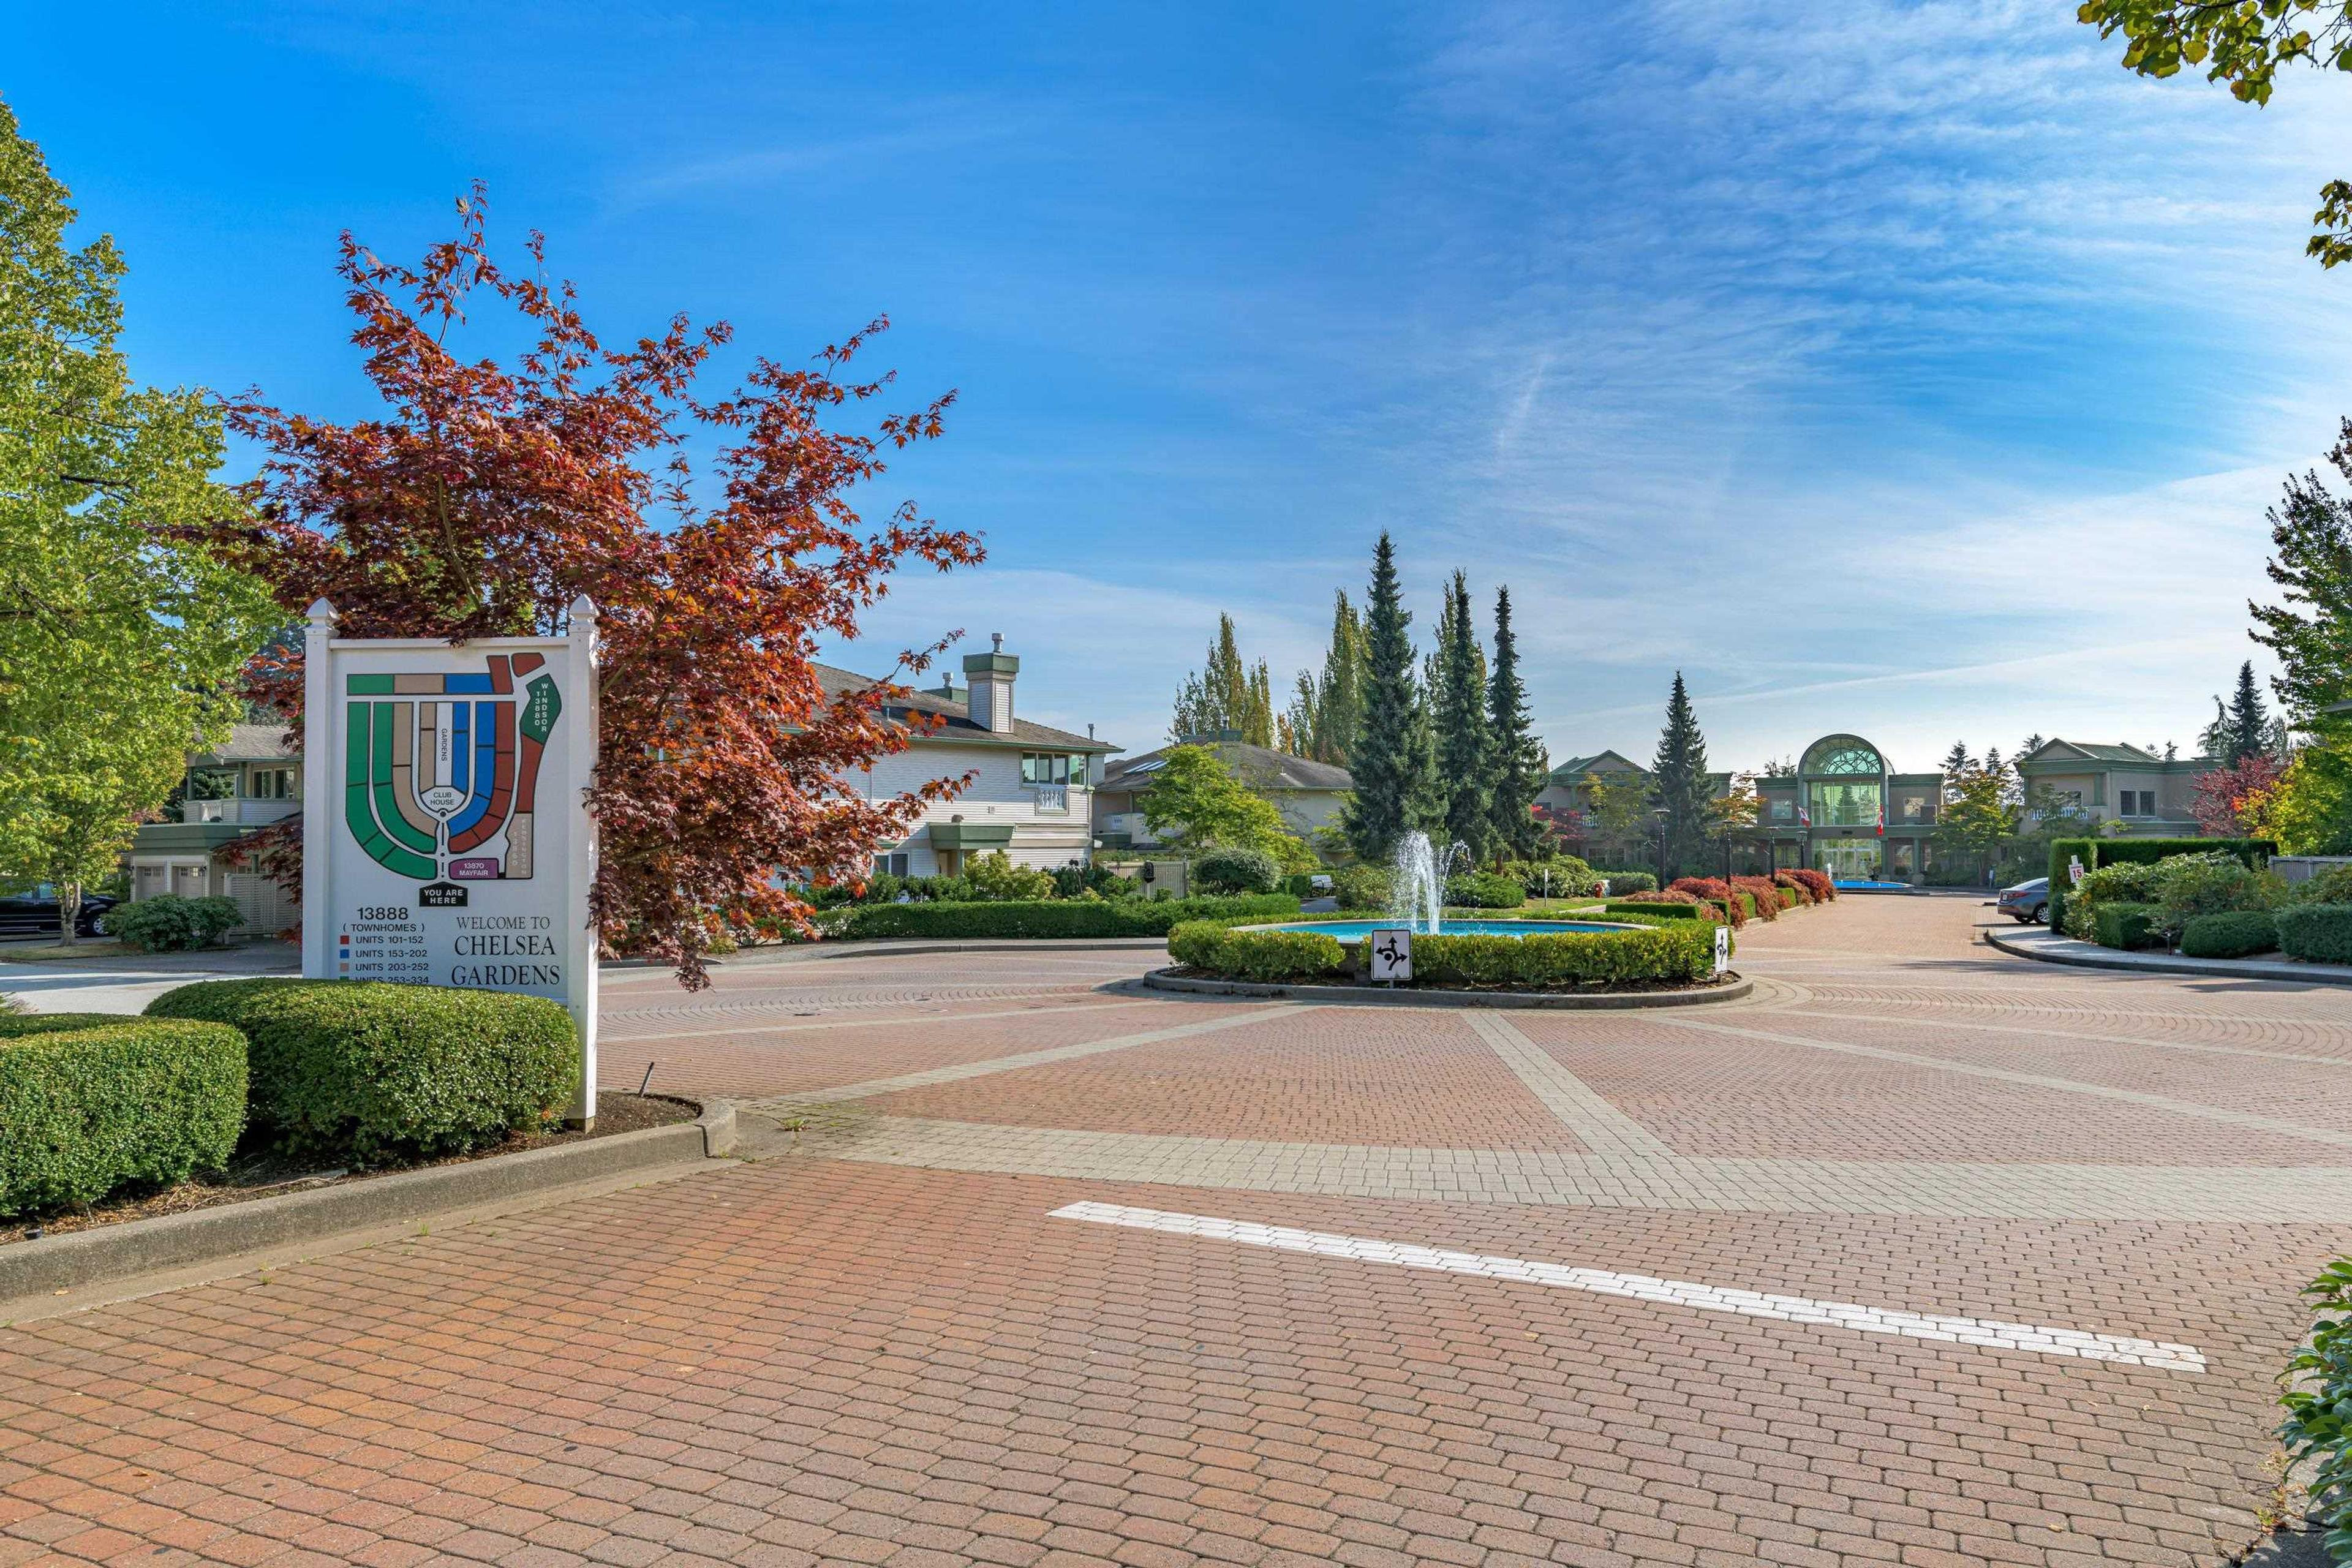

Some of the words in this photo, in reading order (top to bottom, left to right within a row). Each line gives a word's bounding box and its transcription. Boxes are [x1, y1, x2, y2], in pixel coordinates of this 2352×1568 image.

[2073, 869, 2082, 878] 15
[357, 907, 409, 920] 13888
[456, 916, 526, 929] WELCOME
[530, 916, 550, 929] TO
[454, 935, 556, 956] CHELSEA
[451, 965, 560, 986] GARDENS
